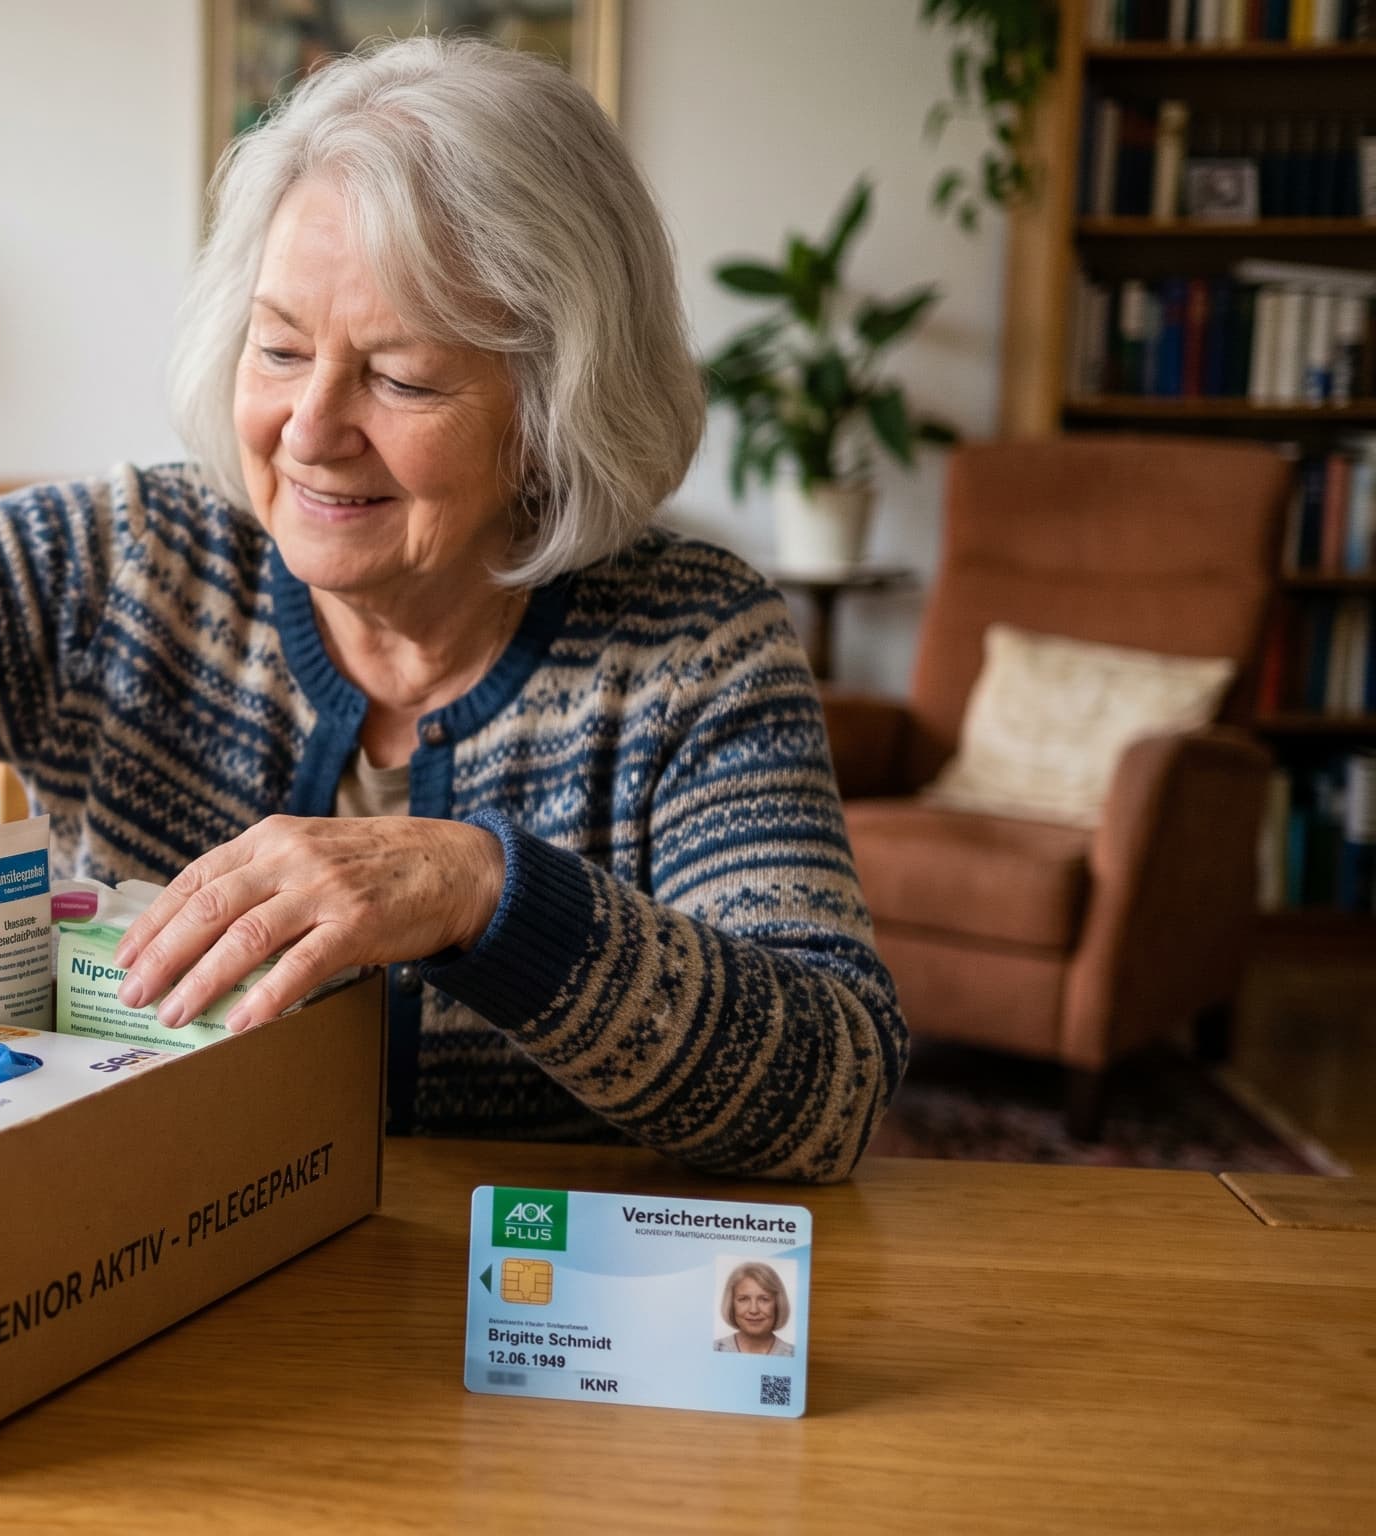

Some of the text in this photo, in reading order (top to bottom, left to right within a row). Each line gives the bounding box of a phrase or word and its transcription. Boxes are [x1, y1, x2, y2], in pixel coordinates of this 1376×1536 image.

[90, 1227, 165, 1298] AKTIV
[187, 1142, 334, 1248] PFLEGEPAKET
[505, 1202, 553, 1224] AOK
[622, 1206, 797, 1233] Versichertenkarte
[504, 1226, 552, 1241] PLUS
[488, 1328, 612, 1350] Brigitte Schmidt
[488, 1350, 566, 1368] 12.06.1949
[580, 1377, 618, 1393] IKNR
